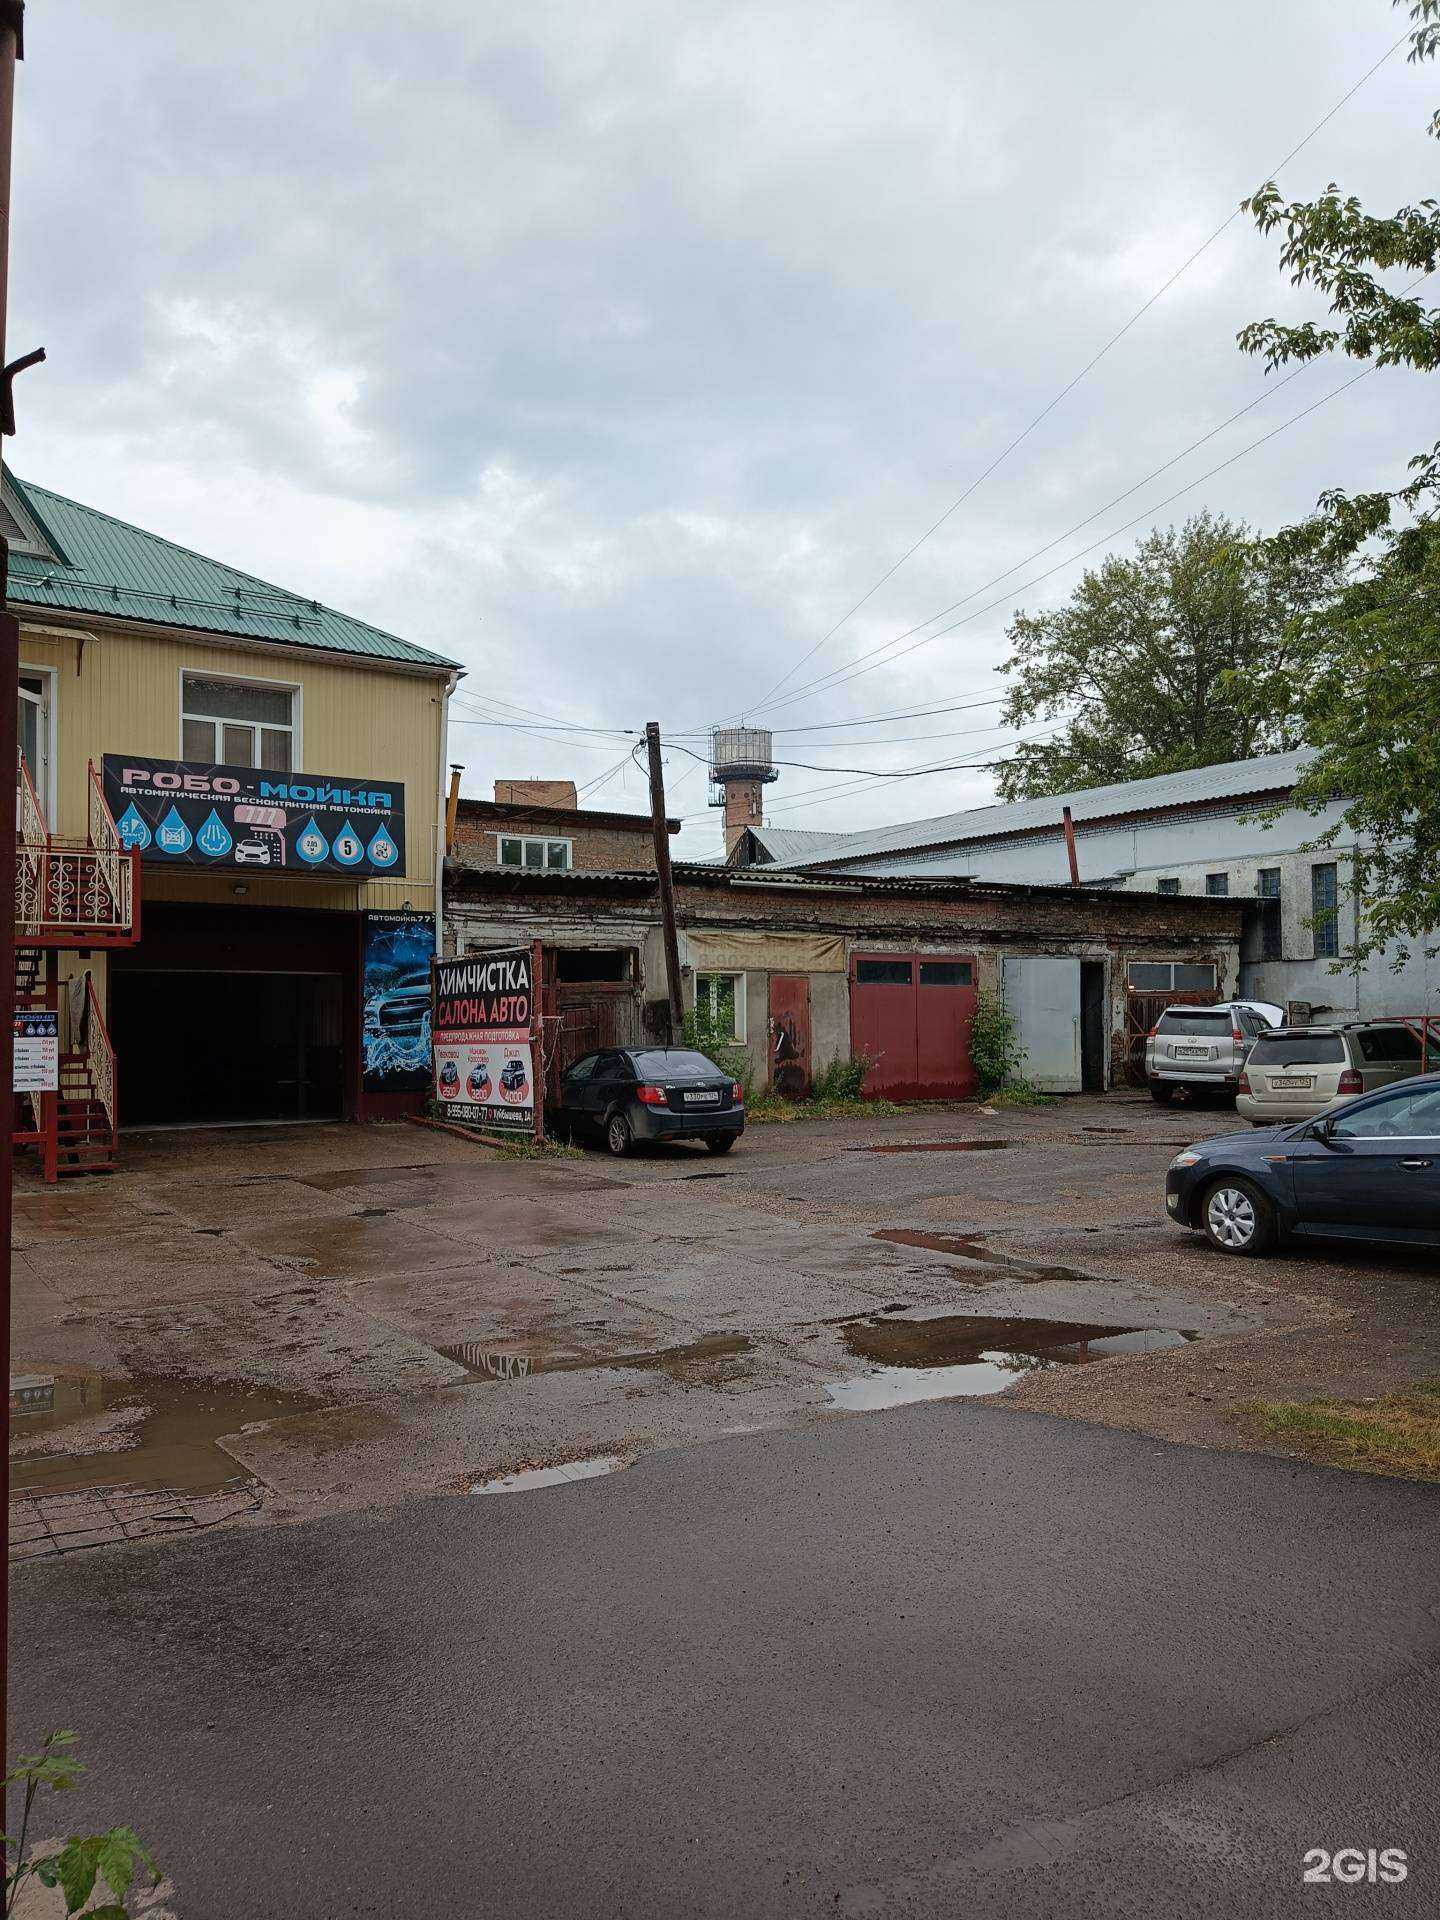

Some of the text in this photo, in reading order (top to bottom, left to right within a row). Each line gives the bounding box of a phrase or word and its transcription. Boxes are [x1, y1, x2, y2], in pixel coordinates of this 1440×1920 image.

[120, 786, 231, 802] АВТОМАТИЧЕСКАЯ
[122, 768, 240, 794] РОБО
[260, 781, 392, 808] МОЙКА
[344, 840, 352, 855] 5
[439, 959, 529, 996] ХИМЧИСТКА
[438, 996, 528, 1025] САЛОНА АВТО
